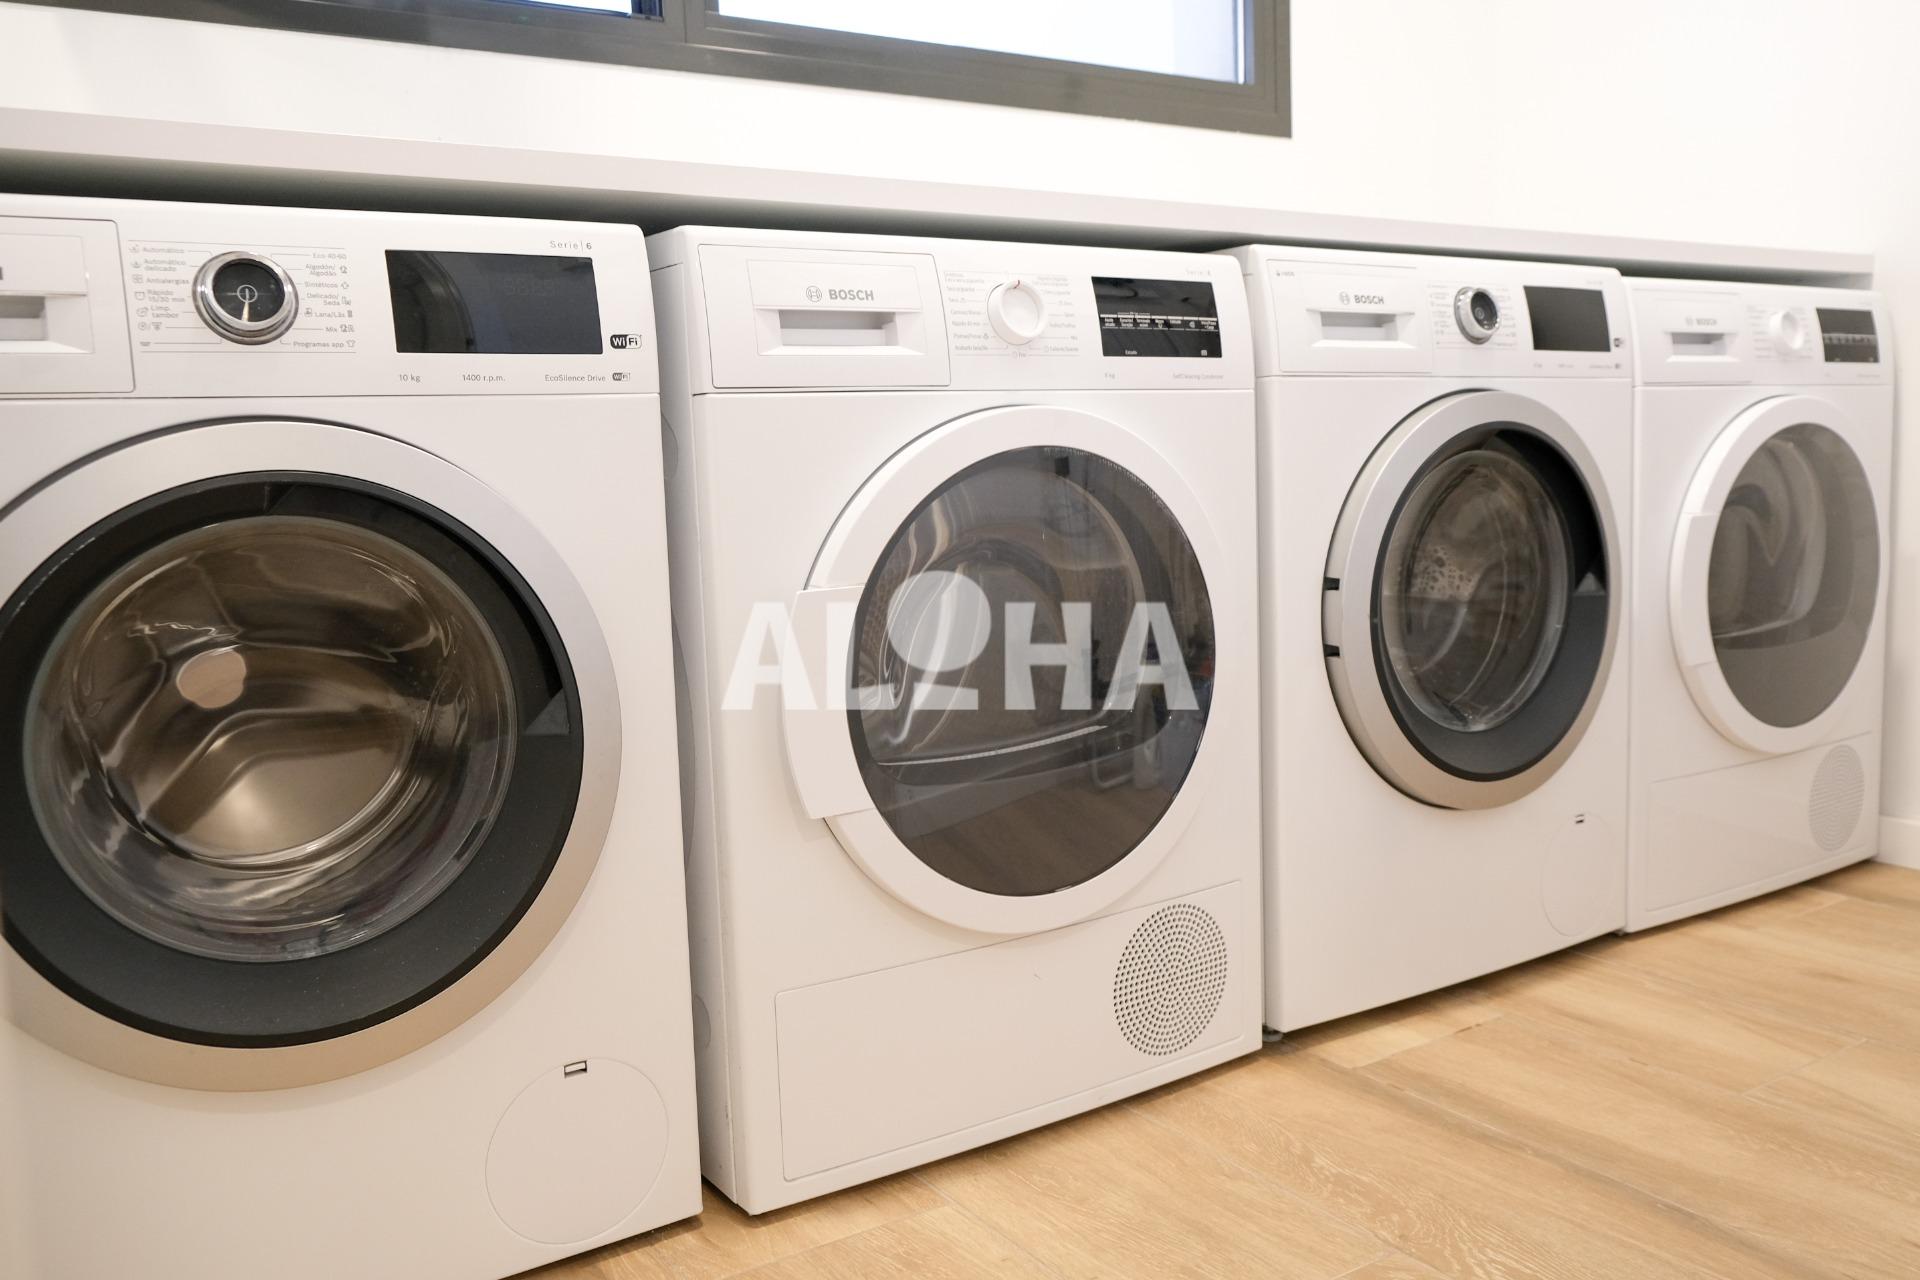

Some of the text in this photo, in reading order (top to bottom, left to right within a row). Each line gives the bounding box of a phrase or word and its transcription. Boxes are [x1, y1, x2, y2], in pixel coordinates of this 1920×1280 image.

[549, 240, 592, 250] Serie 6
[828, 288, 875, 301] BOSCH
[1353, 294, 1385, 305] BOSCH
[292, 341, 330, 349] Programas
[399, 373, 421, 383] 10 kg
[462, 373, 481, 382] 1400
[544, 373, 606, 382] EcoSilence Drive
